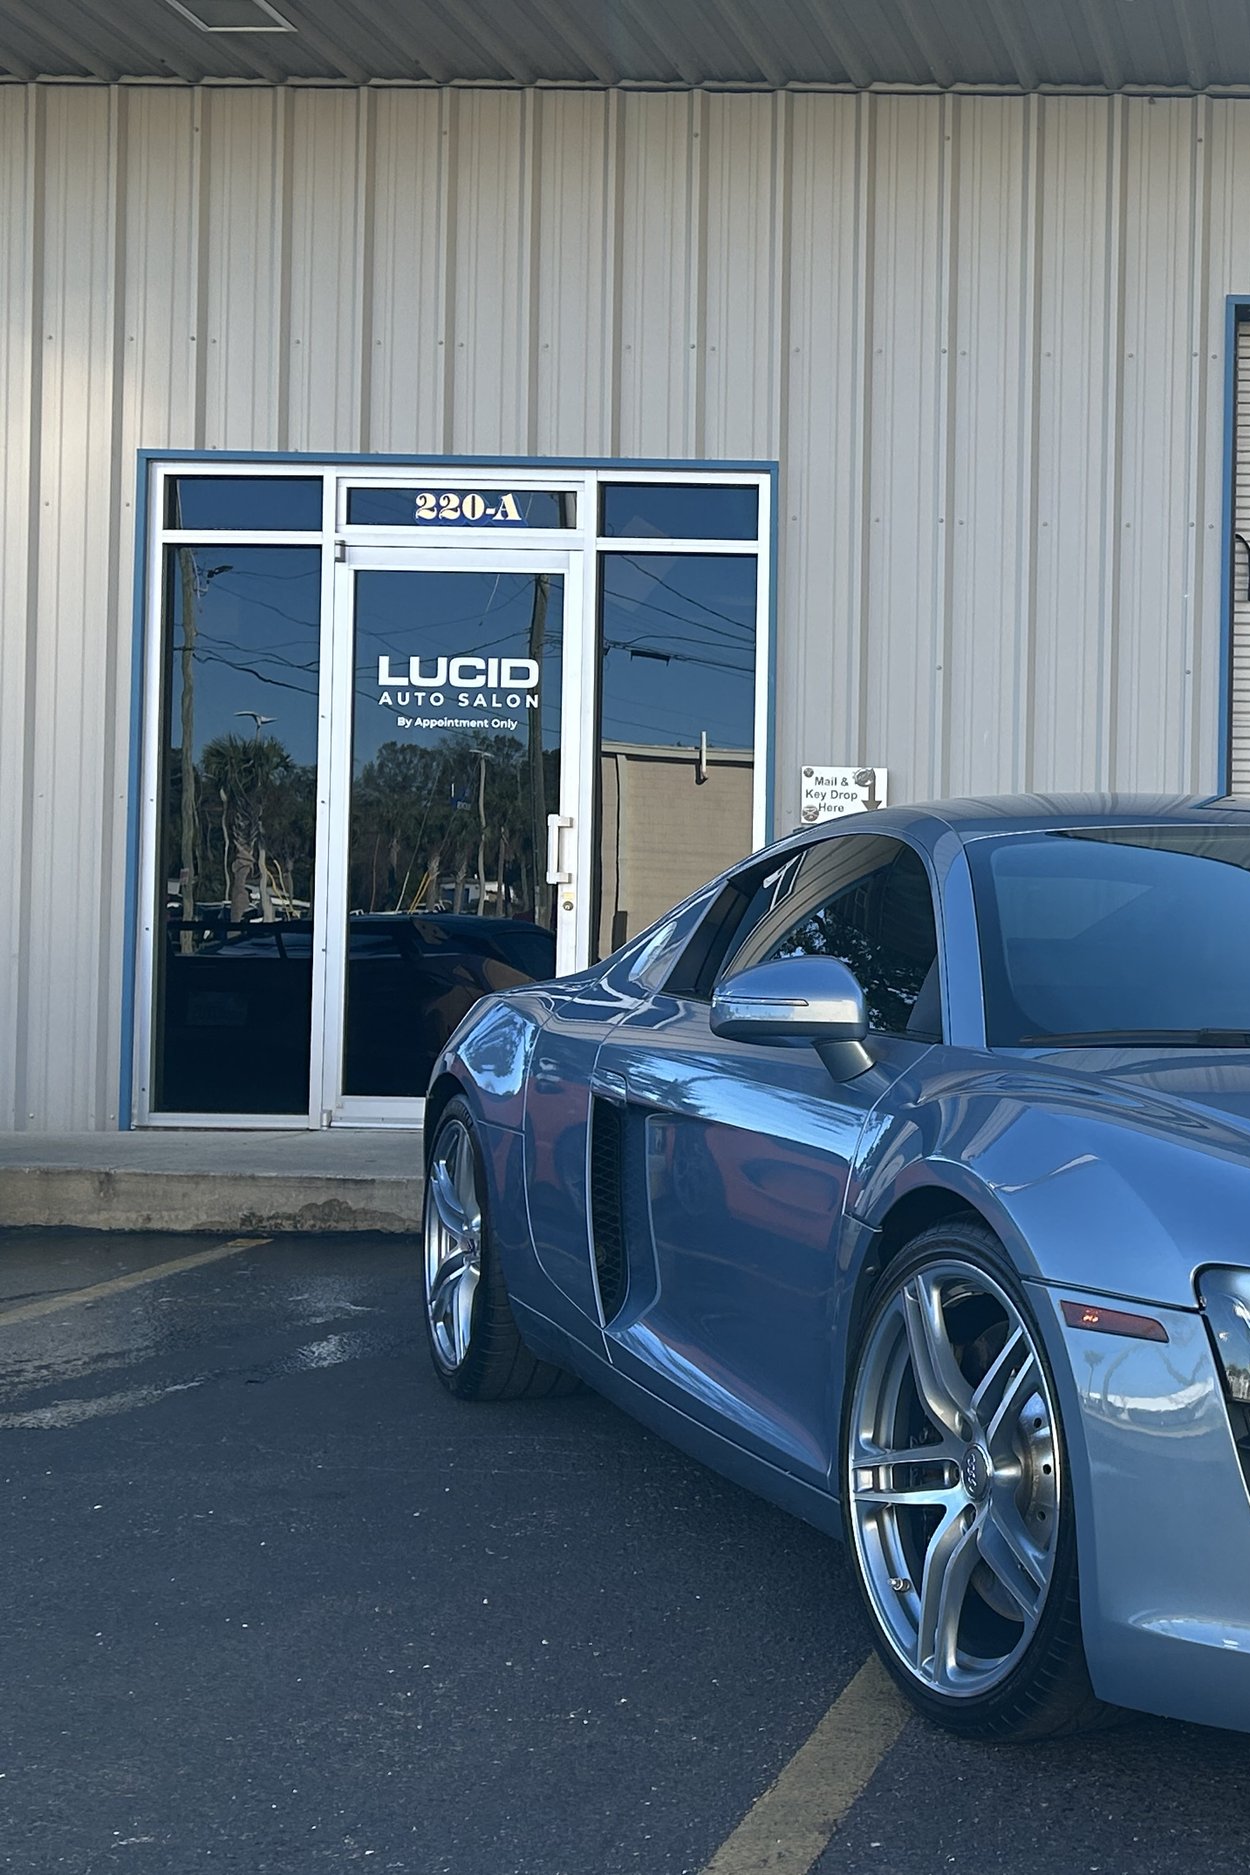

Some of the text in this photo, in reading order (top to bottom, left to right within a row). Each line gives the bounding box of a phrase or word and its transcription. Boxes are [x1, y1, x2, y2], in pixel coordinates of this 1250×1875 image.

[415, 492, 522, 521] 220-A
[378, 655, 540, 689] LUCID
[378, 691, 539, 708] AUTO SALON
[397, 717, 518, 730] By Appointment Only
[814, 776, 849, 787] Mail &
[805, 789, 858, 802] Key Drop
[818, 802, 844, 812] Here
